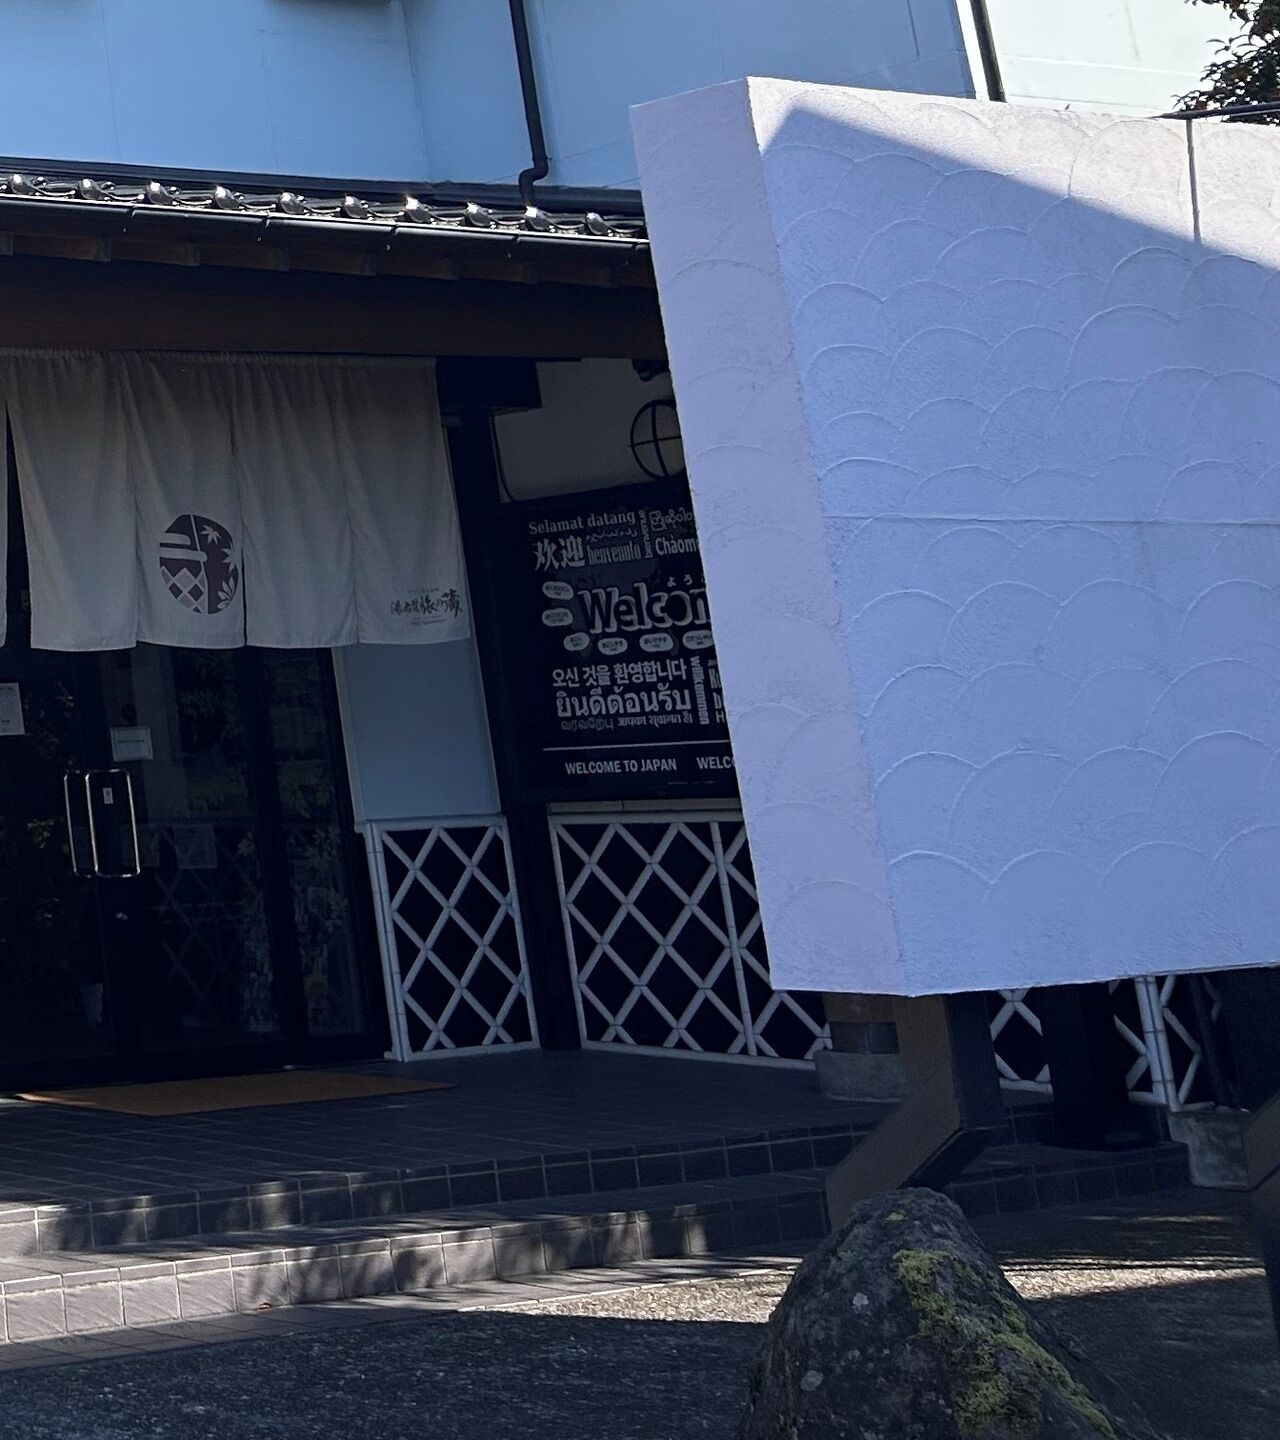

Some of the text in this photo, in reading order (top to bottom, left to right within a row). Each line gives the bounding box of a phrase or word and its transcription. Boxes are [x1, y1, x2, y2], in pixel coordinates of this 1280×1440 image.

[528, 515, 584, 535] Selamat
[587, 510, 636, 528] datang
[533, 534, 586, 572] 欢迎
[551, 666, 581, 688] 오신
[582, 664, 612, 687] 것을
[613, 657, 688, 685] 환영합니다
[555, 682, 692, 718] ยินดีต้อนรับ
[564, 757, 677, 775] WELCOME TO JAPAN
[696, 755, 735, 770] WELC
